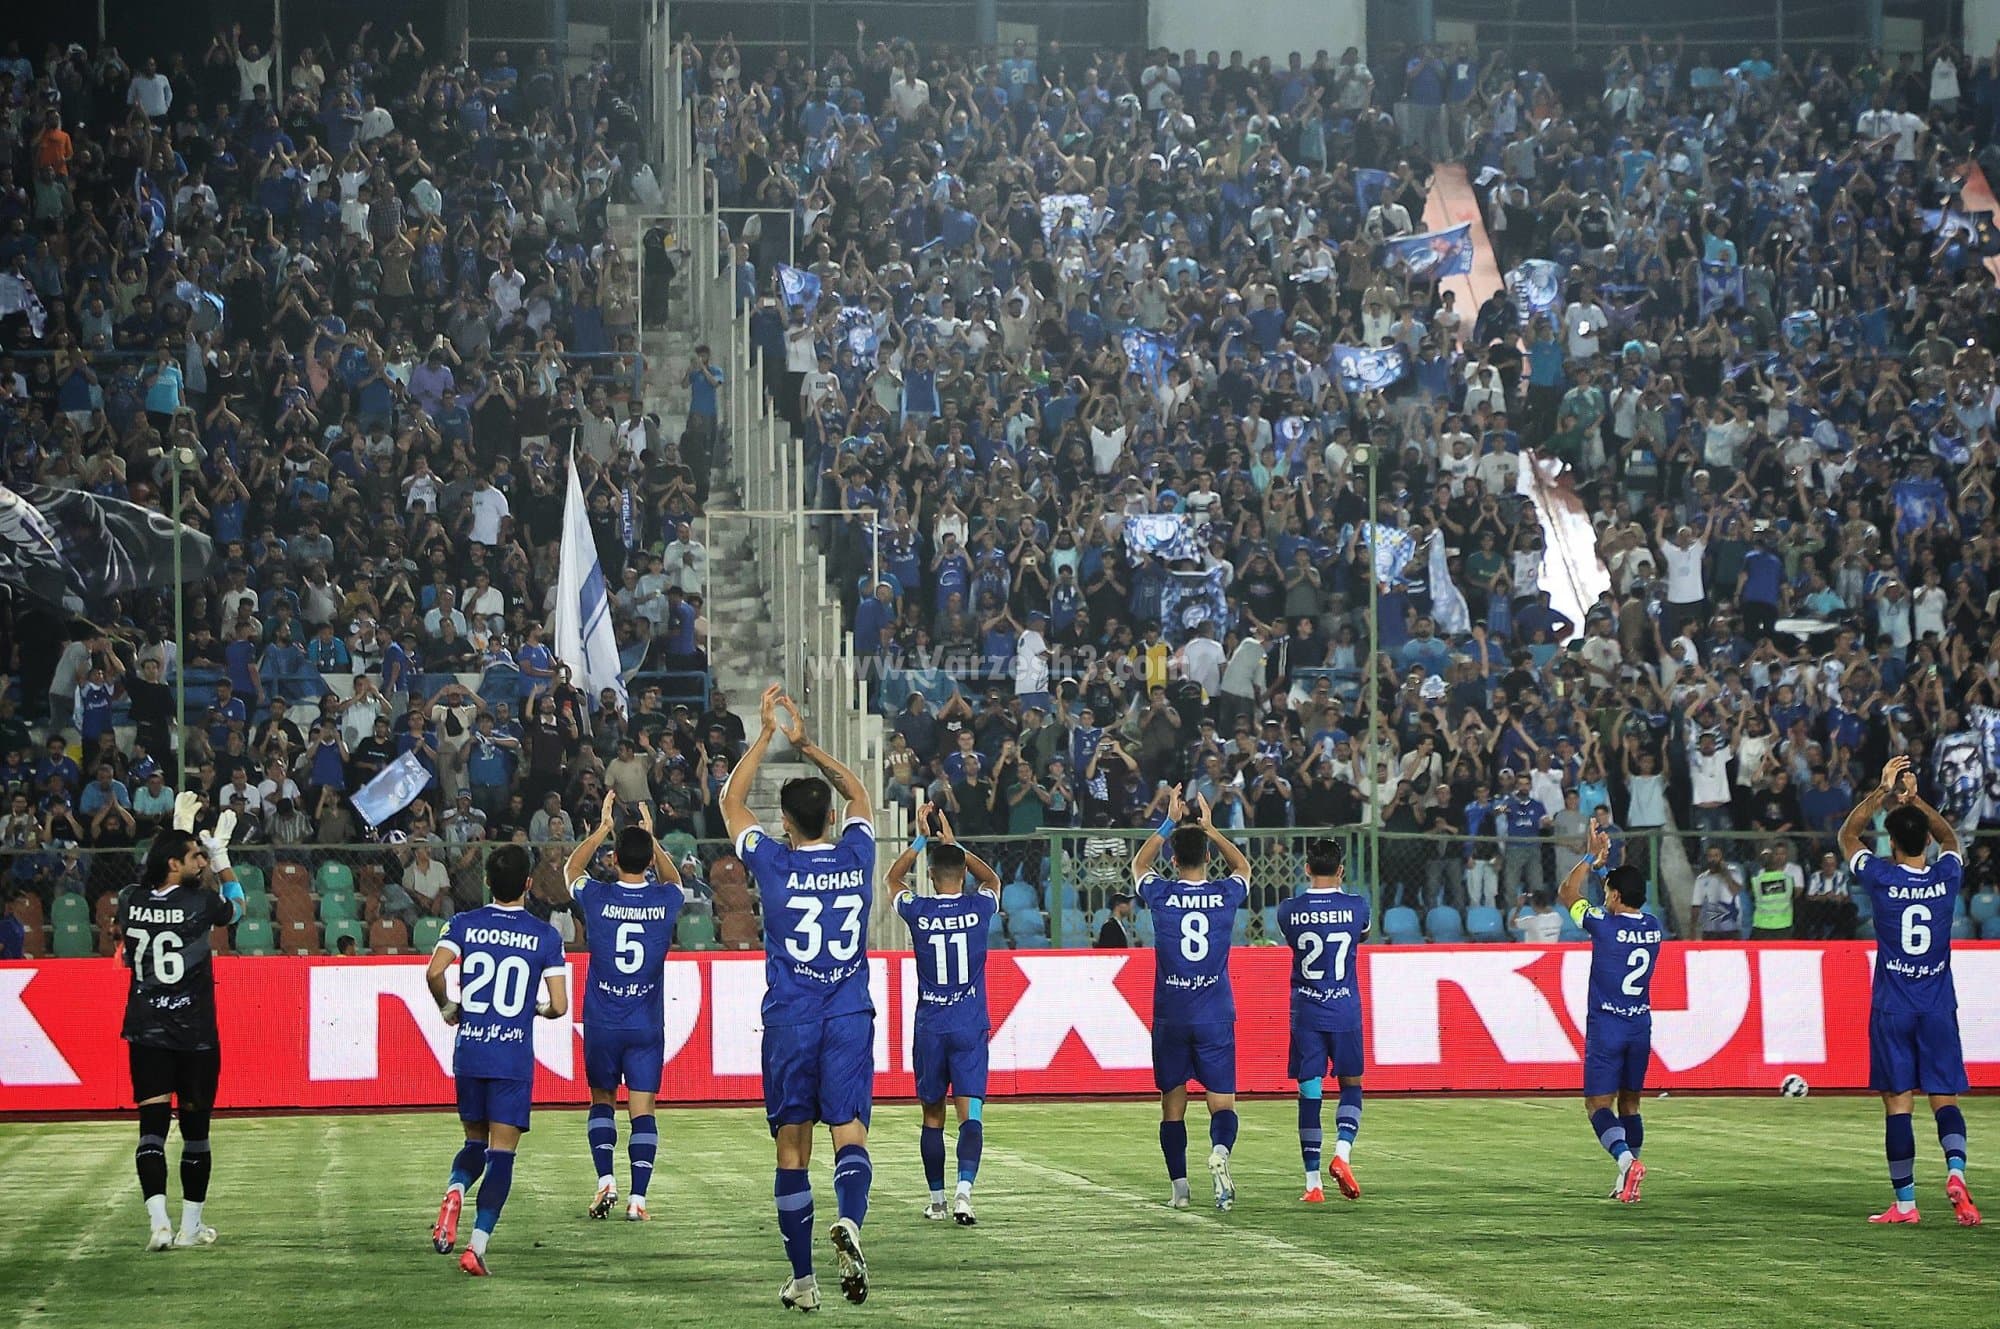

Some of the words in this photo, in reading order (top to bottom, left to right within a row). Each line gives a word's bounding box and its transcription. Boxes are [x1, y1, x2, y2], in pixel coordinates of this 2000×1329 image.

[786, 869, 864, 890] A.AGHASI
[1888, 882, 1947, 899] SAMAN
[128, 905, 184, 924] HABIB
[601, 904, 665, 920] ASHURMATOV
[1165, 894, 1224, 909] AMIR
[1290, 910, 1353, 925] HOSSEIN
[785, 894, 864, 963] 33
[918, 913, 979, 930] SAEID
[1180, 911, 1209, 962] 8
[1616, 930, 1661, 944] SALEH
[1901, 904, 1932, 956] 6
[126, 927, 185, 984] 76
[465, 928, 539, 952] KOOSHKI
[614, 922, 646, 974] 5
[1297, 931, 1352, 981] 27
[928, 933, 969, 985] 11
[1621, 947, 1650, 996] 2
[461, 951, 531, 1018] 20
